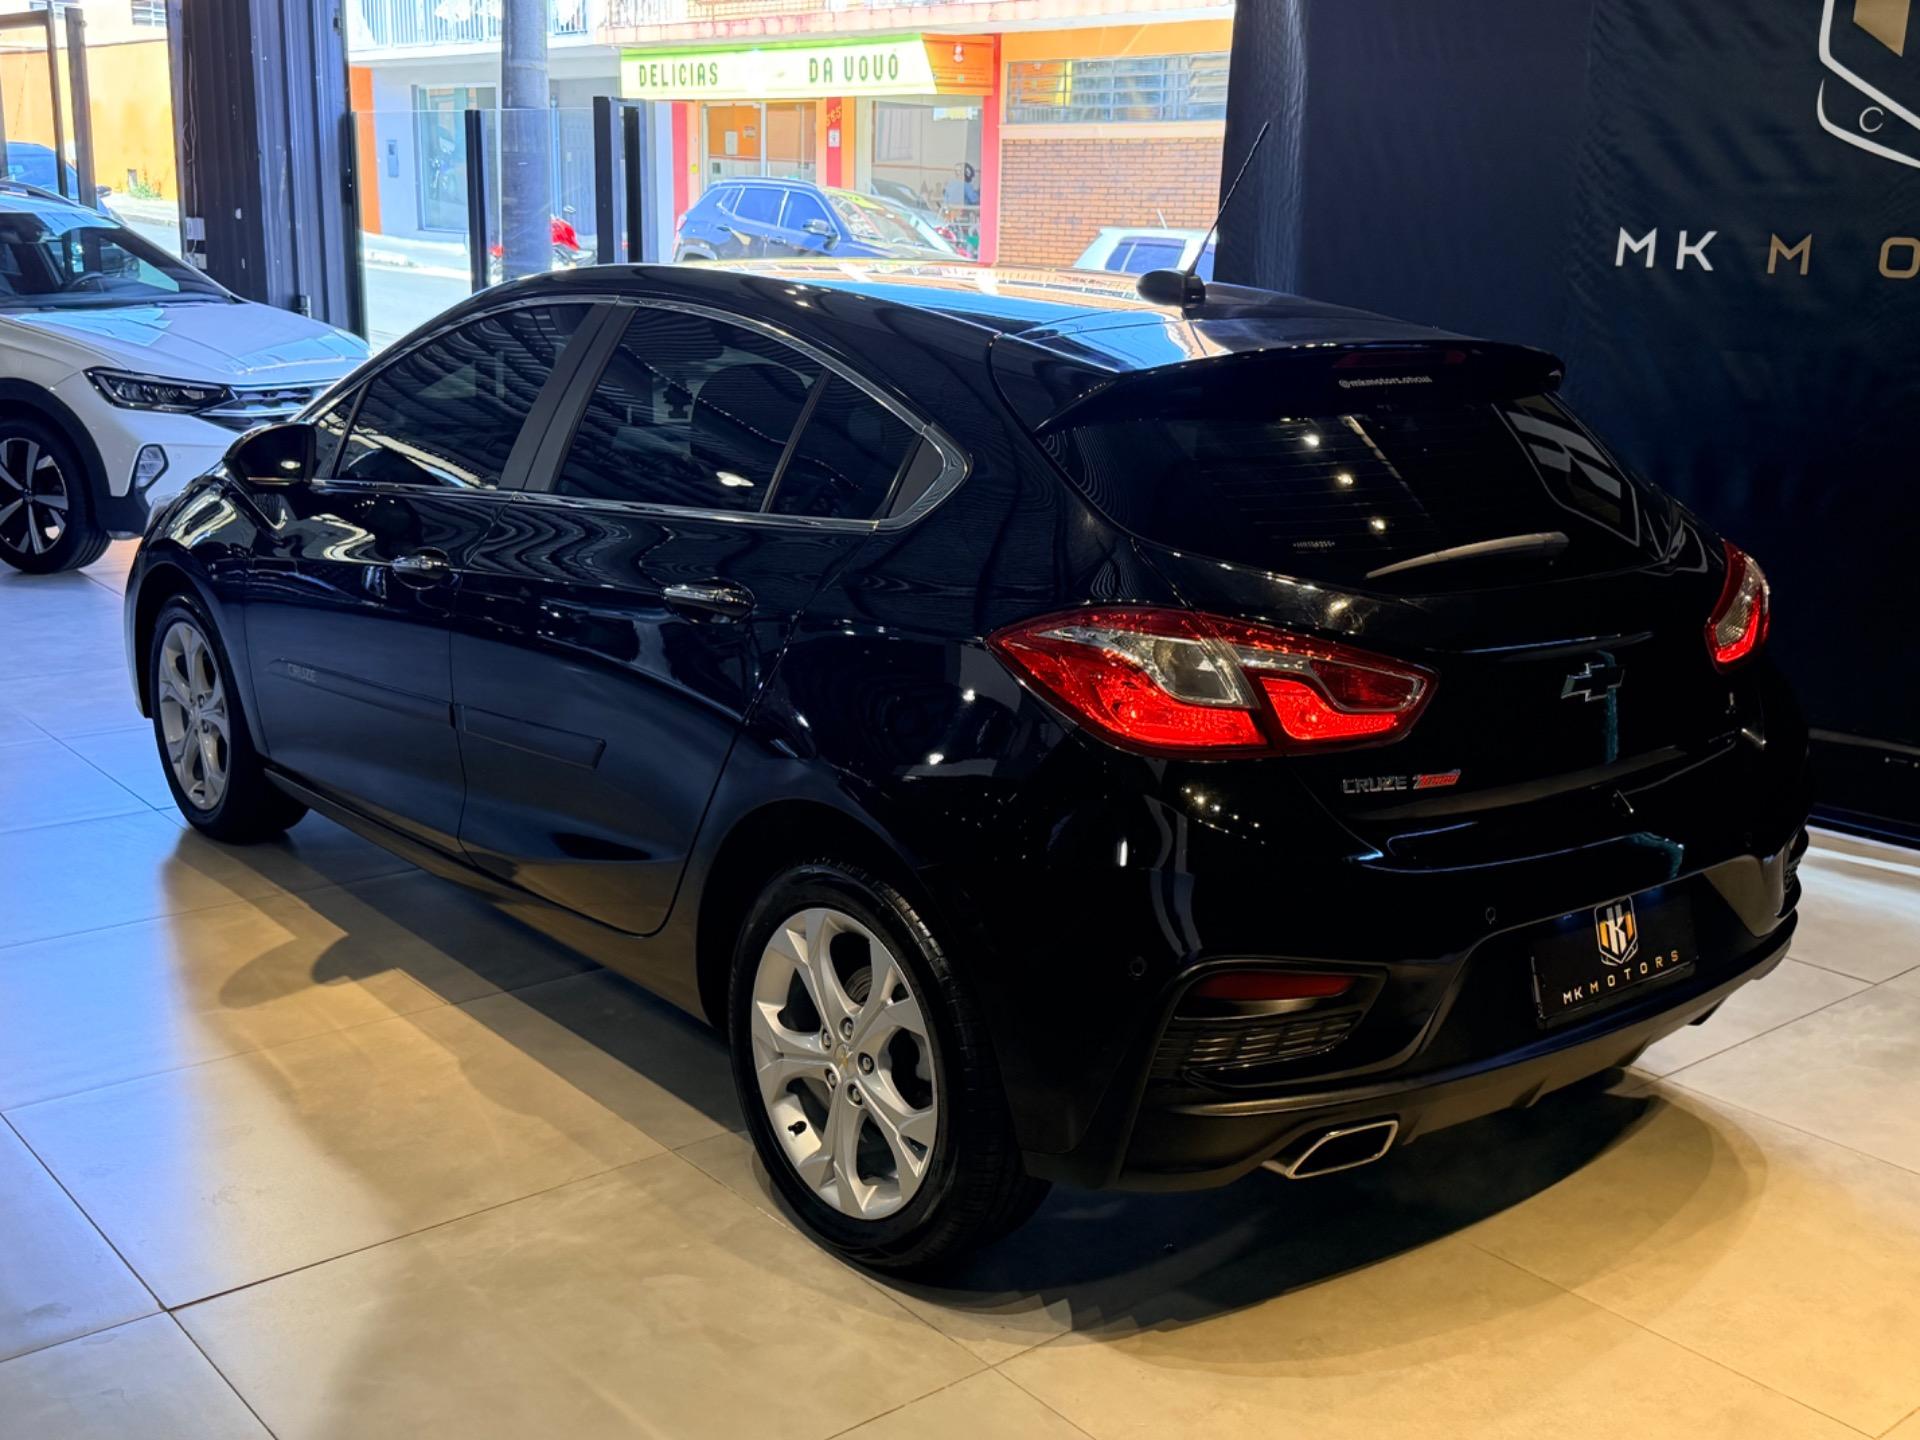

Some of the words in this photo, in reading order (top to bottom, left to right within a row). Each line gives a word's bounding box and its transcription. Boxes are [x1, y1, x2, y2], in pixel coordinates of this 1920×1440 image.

[638, 62, 718, 87] DELICIAS
[809, 57, 832, 83] DA
[1615, 227, 1718, 271] MK
[1343, 775, 1407, 793] CRUZE
[1562, 986, 1584, 1005] MK
[1590, 950, 1680, 994] MOTORS
